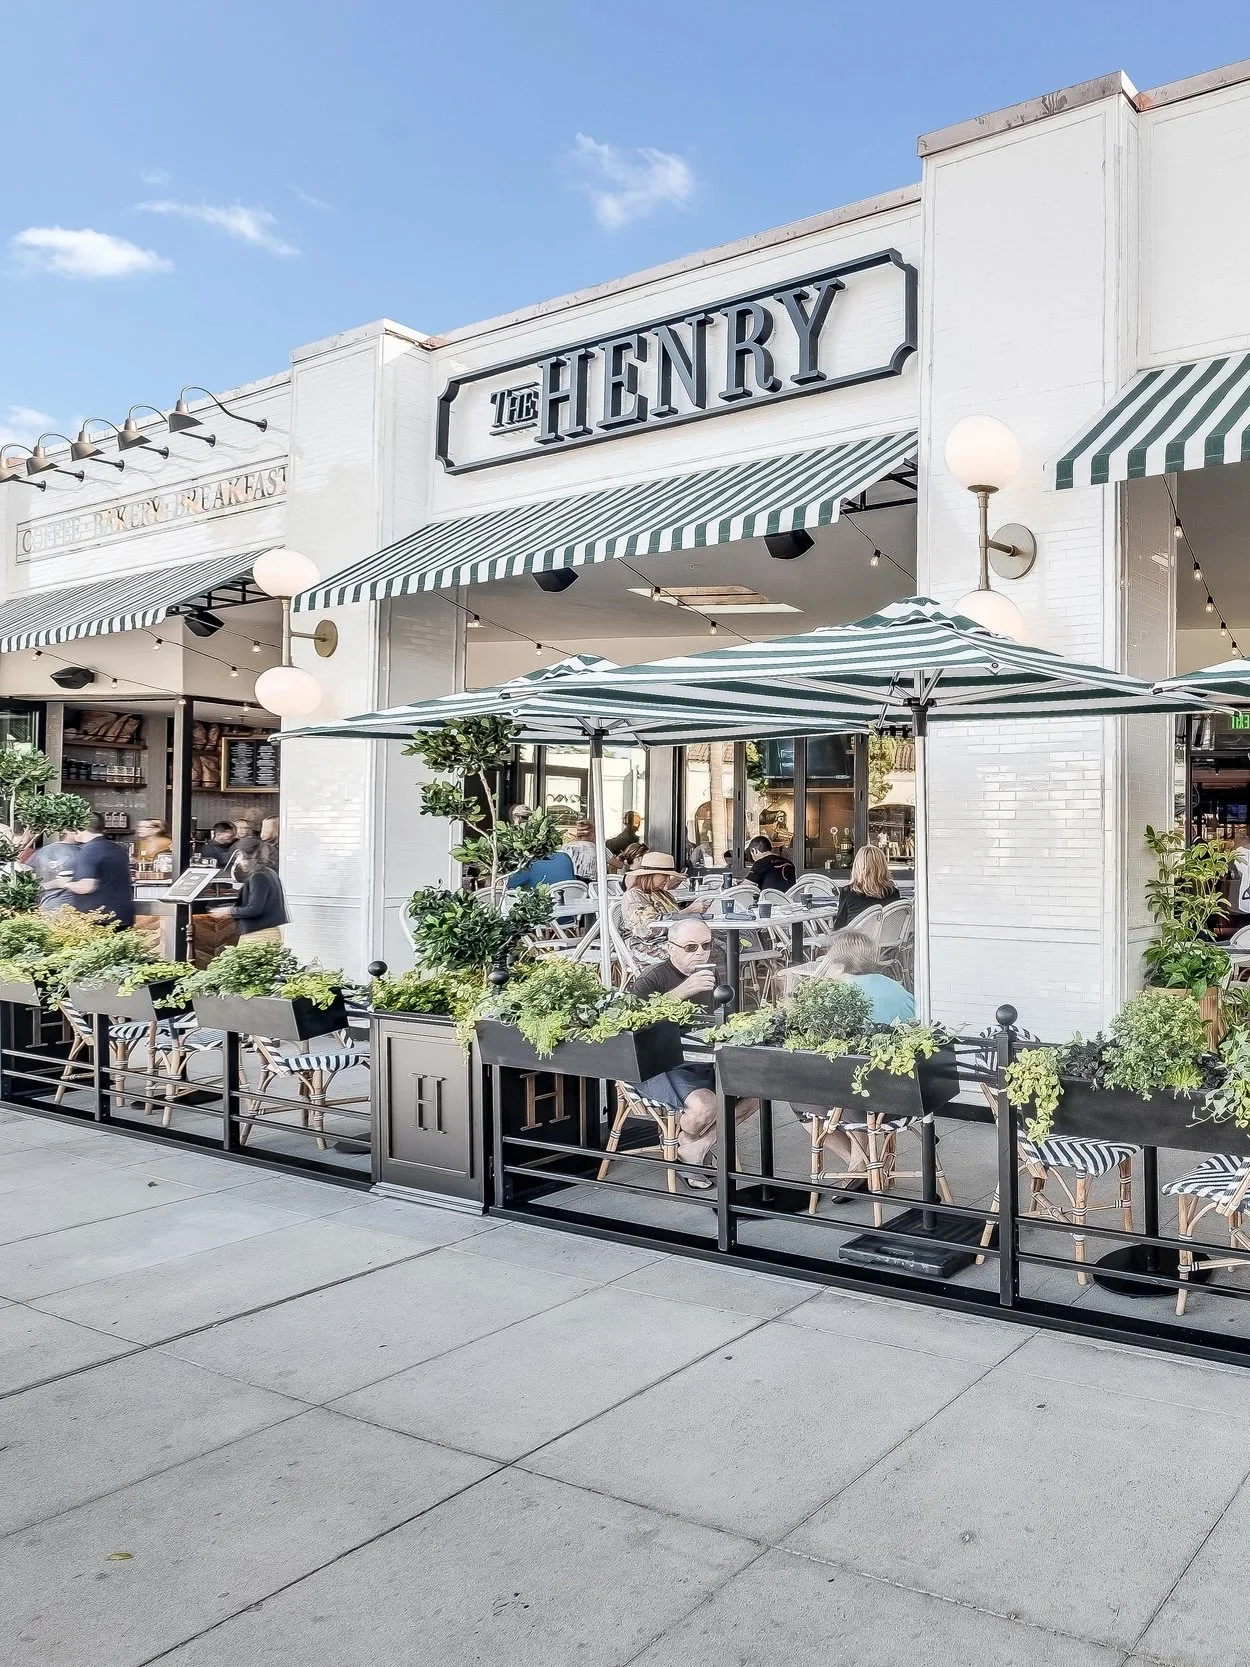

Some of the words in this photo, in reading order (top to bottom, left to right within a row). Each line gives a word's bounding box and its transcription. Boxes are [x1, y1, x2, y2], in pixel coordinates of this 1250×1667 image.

[490, 382, 540, 436] THE
[534, 277, 846, 445] HENRY
[22, 516, 82, 552] COFFEE
[93, 496, 161, 536] BAKERY
[173, 467, 287, 519] BREAKFAST
[410, 1072, 447, 1134] H
[520, 1071, 571, 1132] H
